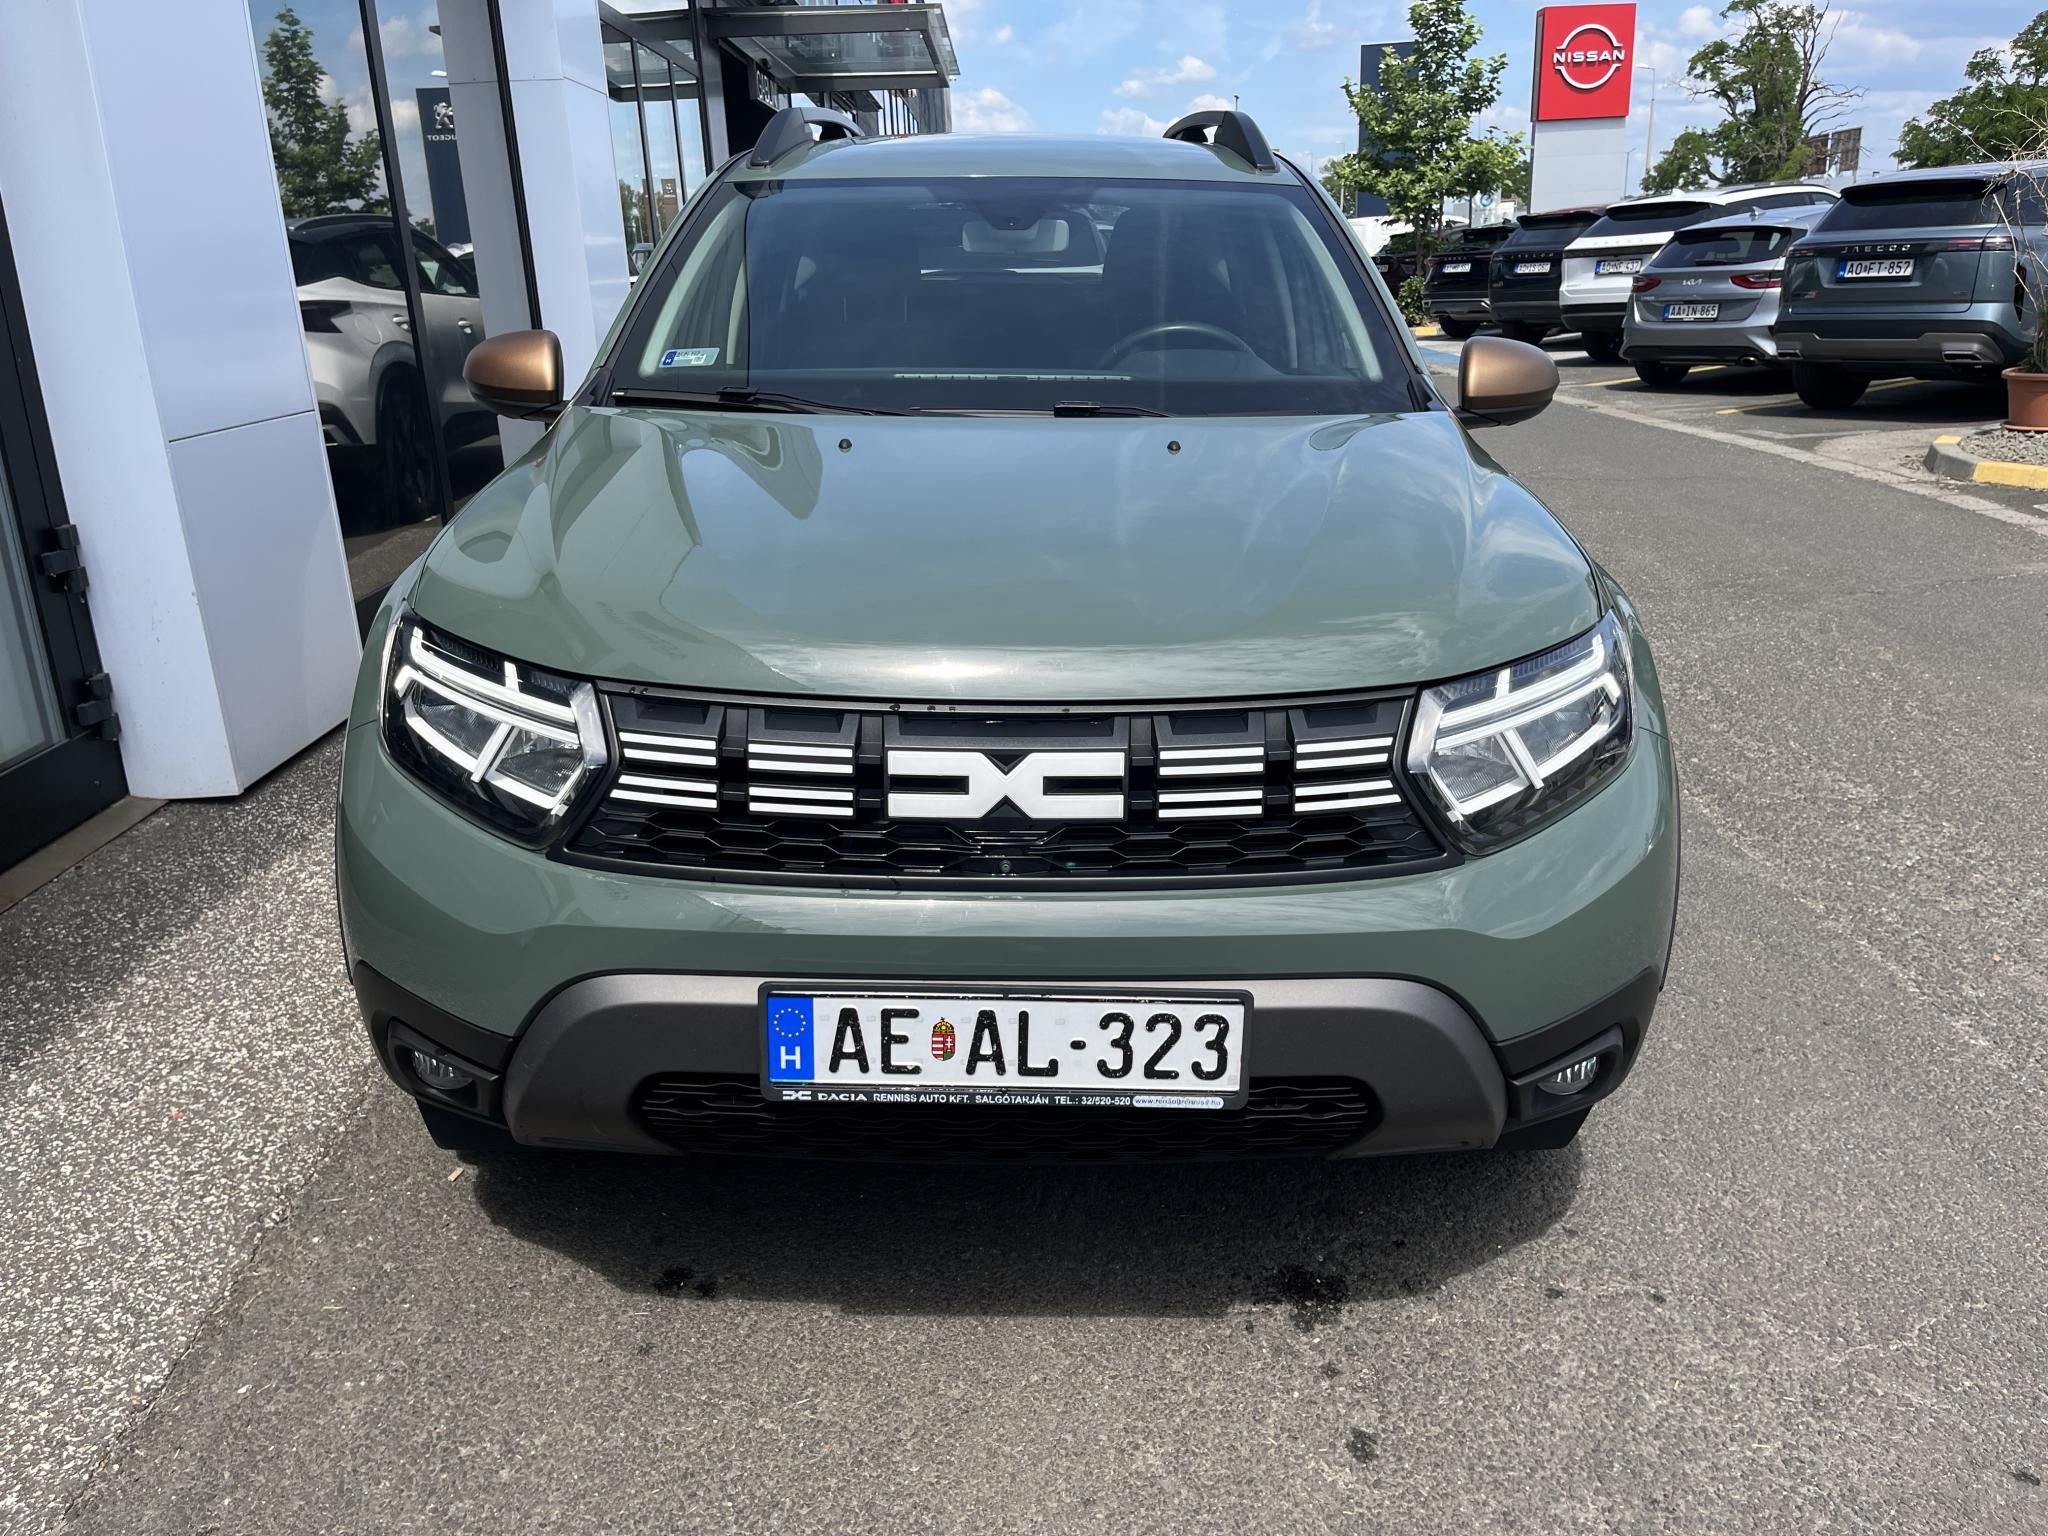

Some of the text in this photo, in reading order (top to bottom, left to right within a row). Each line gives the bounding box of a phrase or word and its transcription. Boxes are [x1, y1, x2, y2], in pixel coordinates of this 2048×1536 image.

[1553, 49, 1625, 63] NISSAN
[1847, 262, 1862, 275] AO
[1867, 260, 1911, 274] FT-857
[1686, 304, 1717, 317] IN-865
[828, 1007, 1231, 1080] AE AL-323
[780, 1045, 801, 1070] H
[817, 1093, 868, 1101] DACIA
[873, 1093, 917, 1103] RENNISS
[919, 1094, 947, 1103] AUTO
[950, 1094, 970, 1103] KFT.
[1054, 1096, 1079, 1105] TEL.:
[1081, 1096, 1131, 1106] 32/520-520
